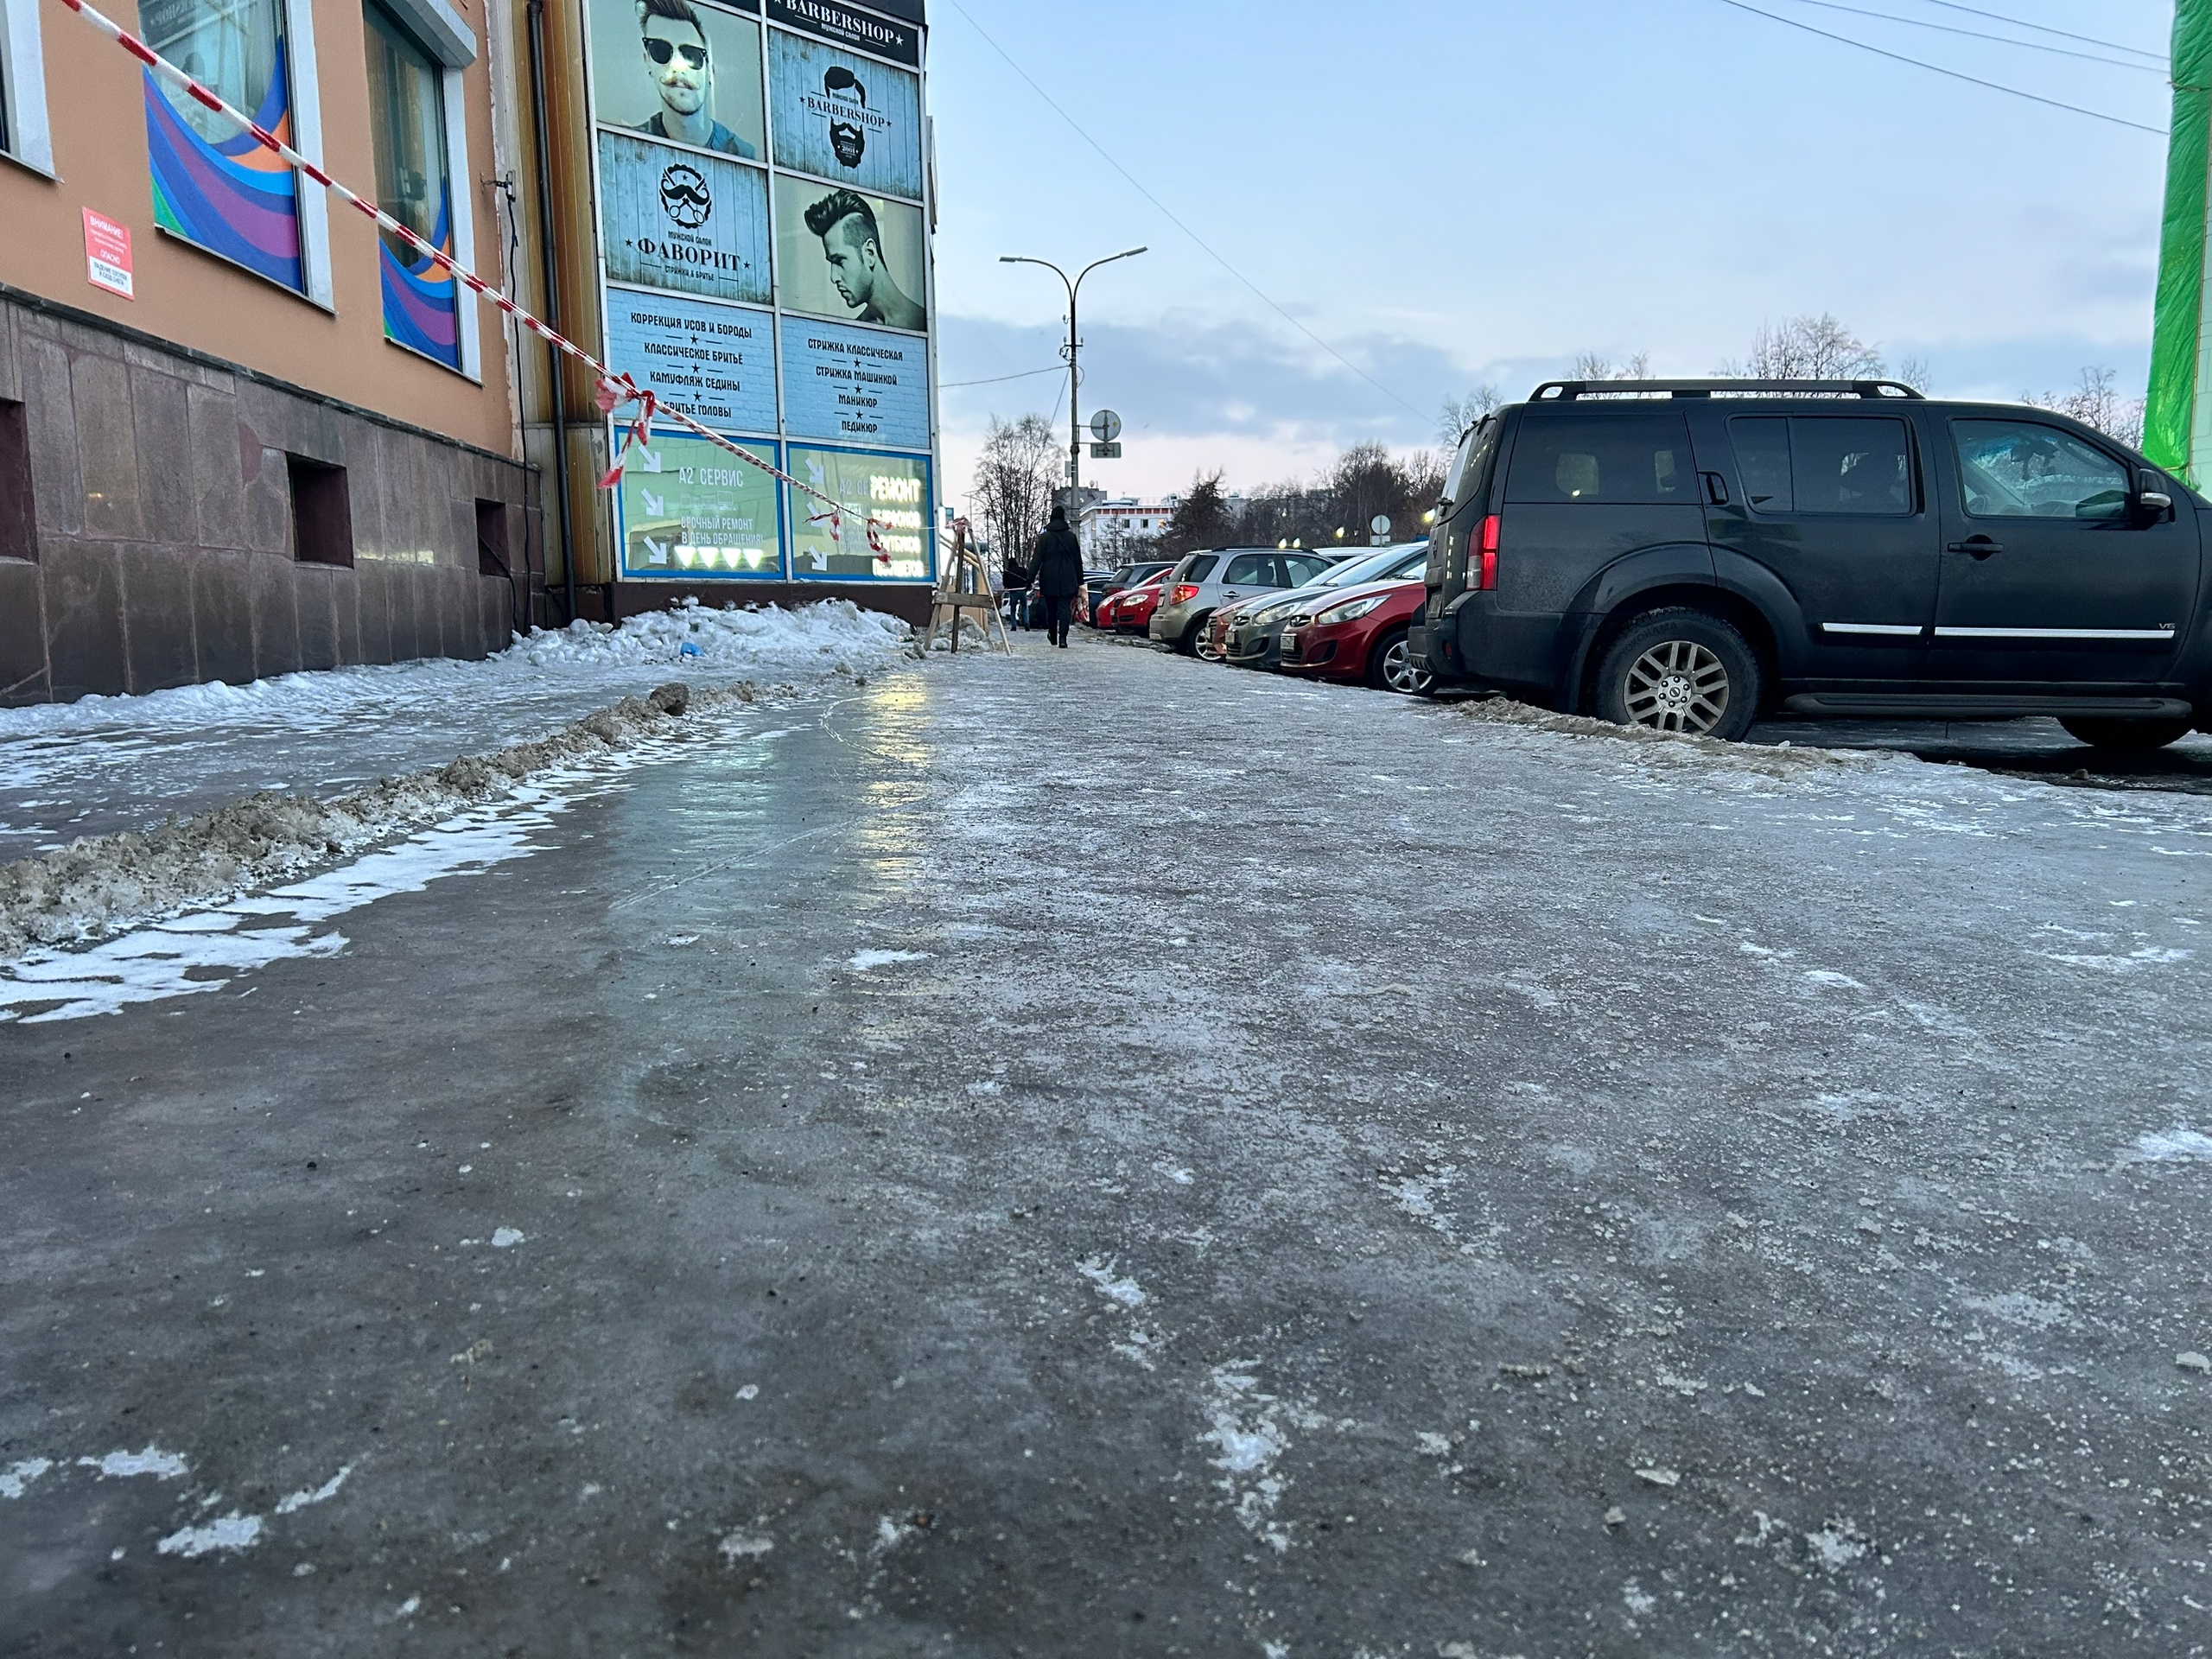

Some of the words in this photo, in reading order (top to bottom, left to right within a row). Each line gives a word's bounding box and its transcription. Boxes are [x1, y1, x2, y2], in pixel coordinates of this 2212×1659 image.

[786, 0, 894, 43] BARBERSHOP
[808, 97, 885, 127] BARBERSHOP
[89, 215, 124, 238] ВНИМАНИЕ!
[668, 231, 694, 243] МУЖСКОЙ
[695, 236, 712, 246] САЛОН
[638, 238, 741, 270] ФАВОРИТ
[631, 312, 682, 328] КОРРЕКЦИЯ
[684, 319, 707, 332] УСОВ
[709, 322, 715, 334] И
[717, 323, 752, 339] БОРОДЫ
[645, 342, 709, 360] КЛАССИЧЕСКОЕ
[712, 351, 743, 365] БРИТЬЁ
[808, 338, 845, 353] СТРИЖКА
[847, 344, 903, 361] КЛАССИЧЕСКАЯ
[650, 371, 703, 387] КАМУФЛЯЖ
[705, 378, 741, 391] СЕДИНЫ
[816, 365, 852, 380] СТРИЖКА
[854, 371, 898, 385] МАШИНКОЙ
[698, 404, 732, 417] ГОЛОВЫ
[838, 394, 878, 408] МАНИКЮР
[842, 420, 878, 434] ПЕДИКЮР
[678, 467, 694, 484] А2
[700, 467, 744, 487] СЕРВИС
[681, 515, 721, 530] СРОЧНЫЙ
[721, 518, 753, 531] РЕМОНТ
[682, 531, 688, 544] В
[689, 532, 711, 546] ДЕНЬ
[713, 533, 763, 546] ОБРАЩЕНИЯ!
